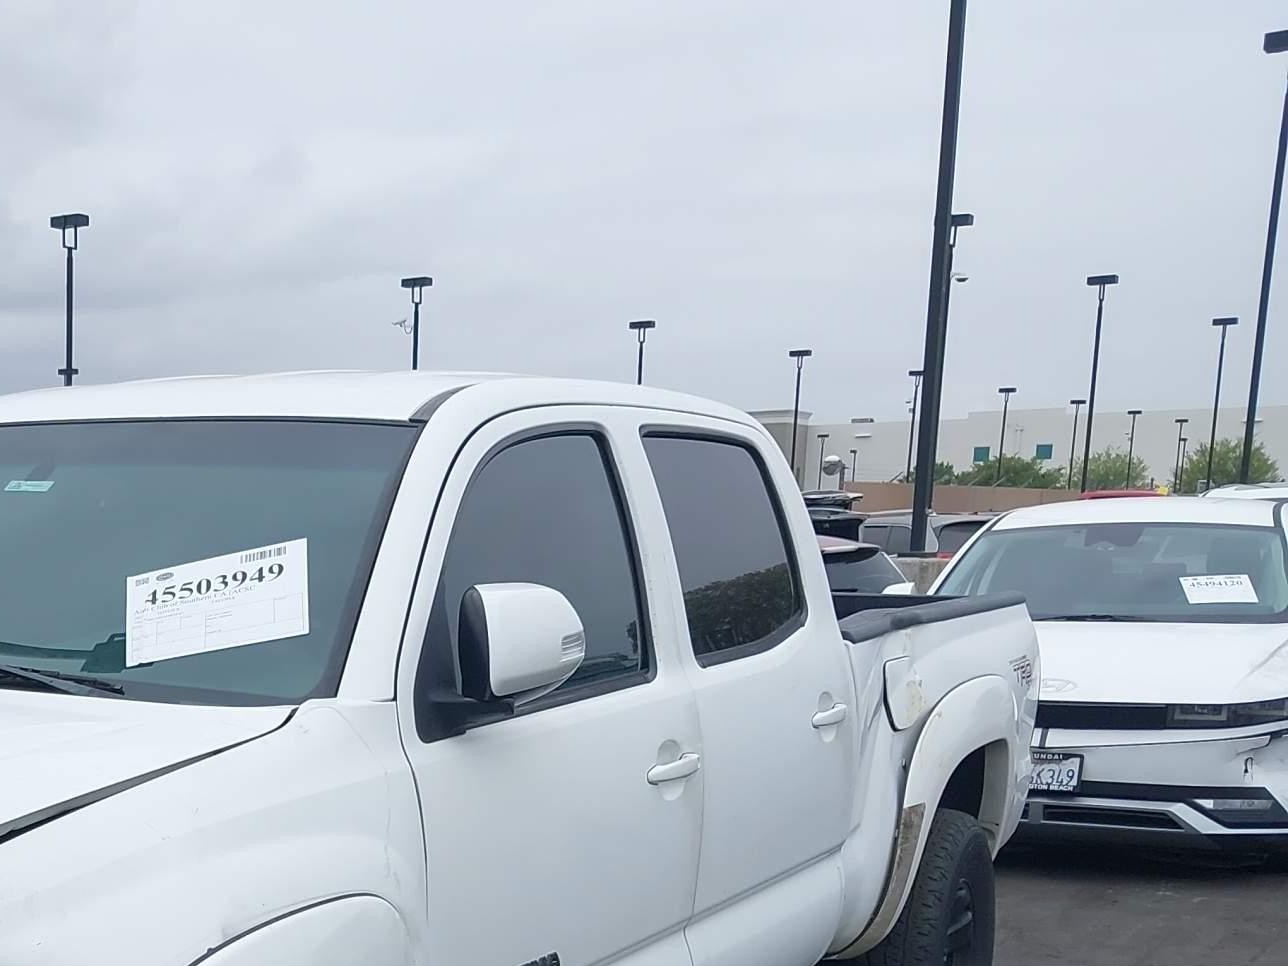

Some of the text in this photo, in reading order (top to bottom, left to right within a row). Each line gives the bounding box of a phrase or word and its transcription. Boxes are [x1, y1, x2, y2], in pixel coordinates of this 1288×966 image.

[144, 563, 285, 605] 45503949
[1032, 767, 1076, 787] K349
[1049, 784, 1074, 792] BEACH
